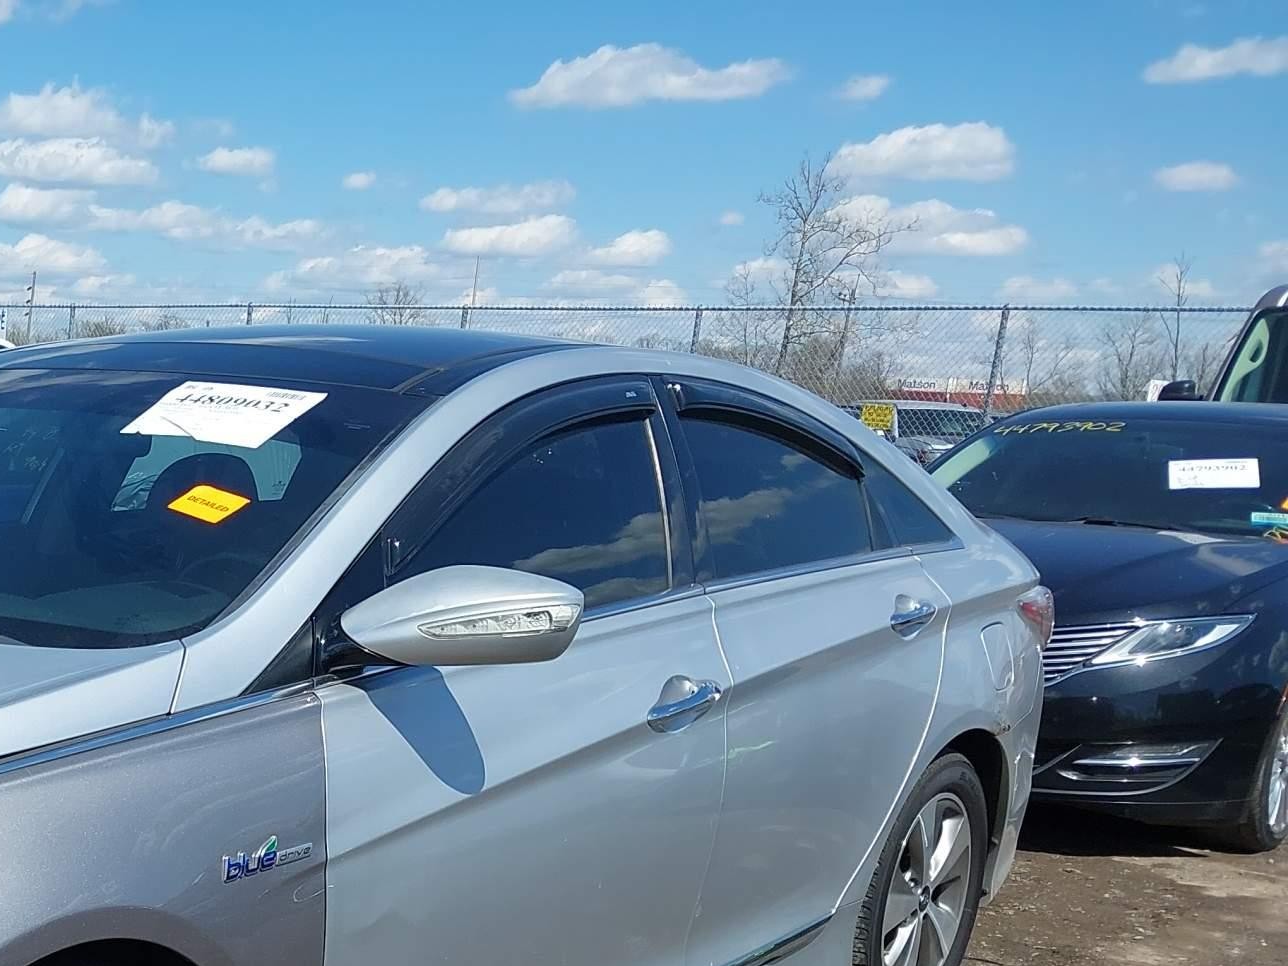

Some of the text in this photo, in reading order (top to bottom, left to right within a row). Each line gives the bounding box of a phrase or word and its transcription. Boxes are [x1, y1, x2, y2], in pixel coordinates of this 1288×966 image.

[897, 379, 936, 389] Matson
[175, 393, 290, 413] 44809032
[994, 421, 1126, 437] 44793902
[187, 494, 230, 512] DETAILED
[222, 851, 277, 883] blue
